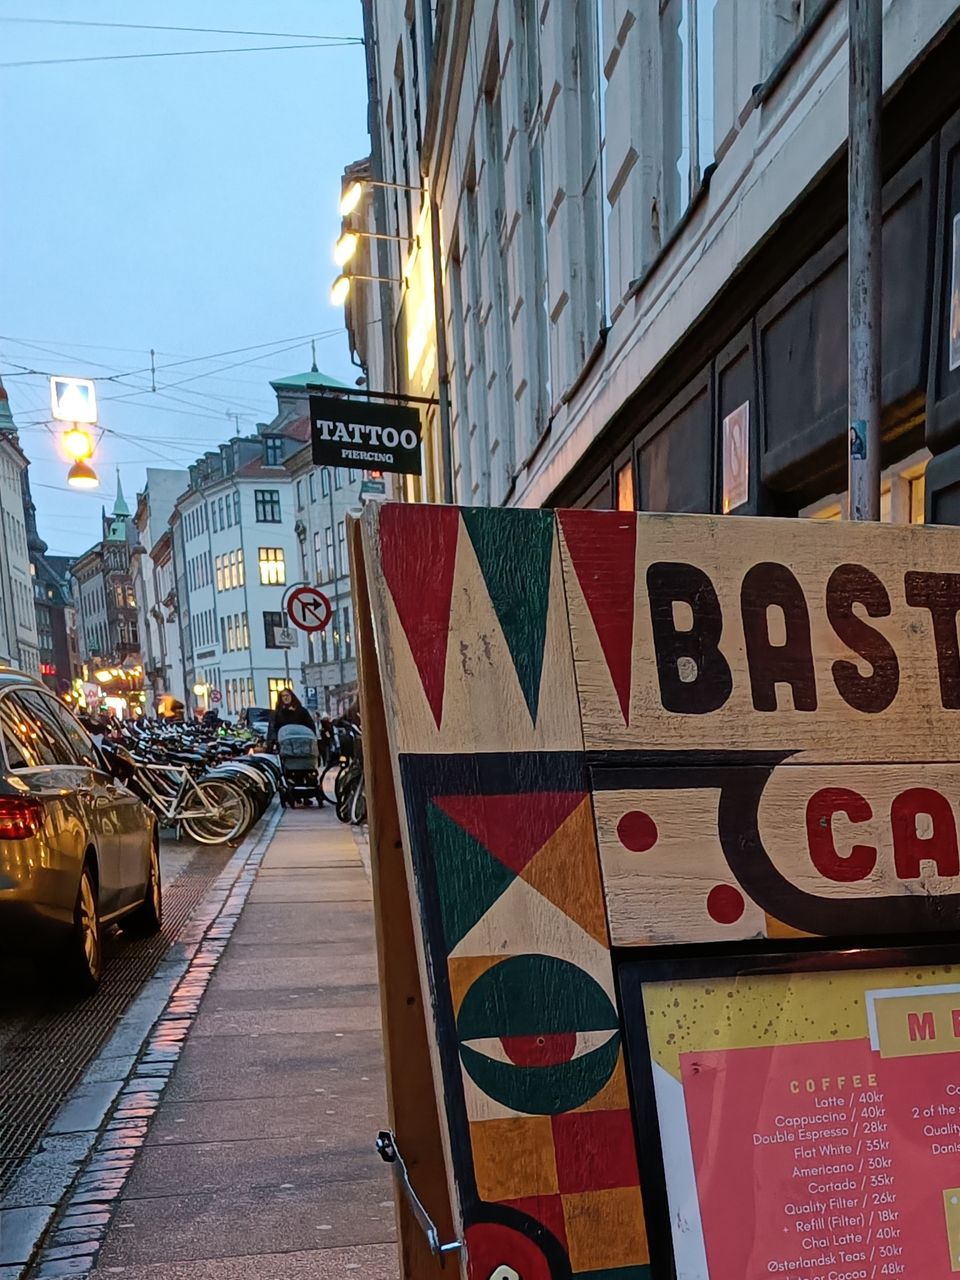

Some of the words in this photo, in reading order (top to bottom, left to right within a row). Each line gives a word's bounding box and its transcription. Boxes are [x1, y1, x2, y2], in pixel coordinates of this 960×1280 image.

[316, 419, 417, 449] TATTOO
[341, 449, 394, 463] PIERCING
[790, 1073, 877, 1093] COFFEE
[814, 1096, 845, 1108] Latte
[858, 1090, 884, 1104] 40kr
[774, 1111, 847, 1129] Cappuccino
[860, 1104, 886, 1122] 40kr
[752, 1129, 795, 1145] Double
[797, 1127, 849, 1142] Espresso
[862, 1118, 887, 1134] 28kr
[794, 1145, 816, 1159] Flat
[818, 1143, 852, 1156] White
[865, 1137, 889, 1152] 35kr
[792, 1163, 854, 1177] Americano
[867, 1155, 892, 1169] 30kr
[807, 1177, 857, 1194] Cortado
[870, 1172, 894, 1187] 35kr
[784, 1200, 826, 1215] Quality
[829, 1196, 858, 1210] Filter
[871, 1190, 896, 1204] 26kr
[801, 1236, 830, 1249] Chai
[832, 1233, 862, 1246] Latte
[876, 1226, 900, 1239] 40kr
